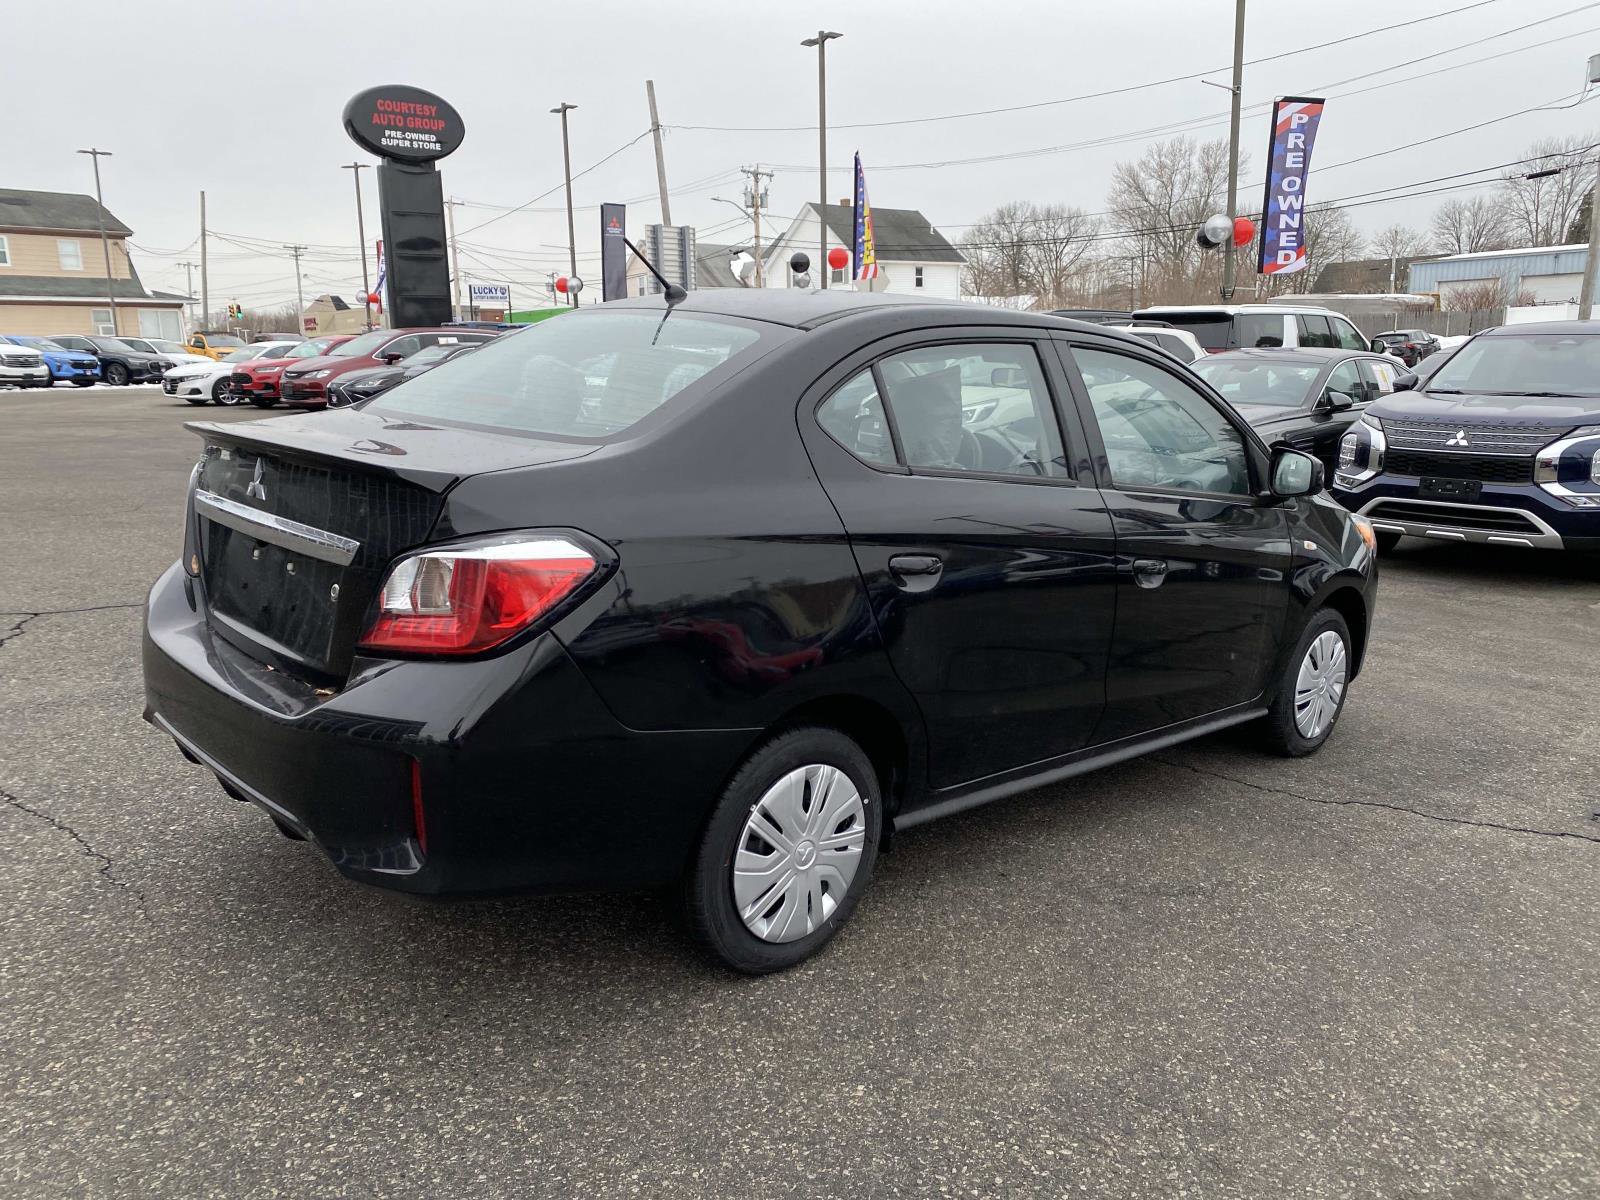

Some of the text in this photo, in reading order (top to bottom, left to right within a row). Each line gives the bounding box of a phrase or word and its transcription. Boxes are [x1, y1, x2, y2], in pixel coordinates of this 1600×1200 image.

[377, 99, 437, 116] COURTESY
[372, 112, 445, 130] AUTO GROUP
[385, 129, 436, 142] PRE-OWNED
[381, 137, 442, 150] SUPER STORE
[1277, 113, 1309, 265] PRE OWNED
[474, 286, 498, 295] LUCKY
